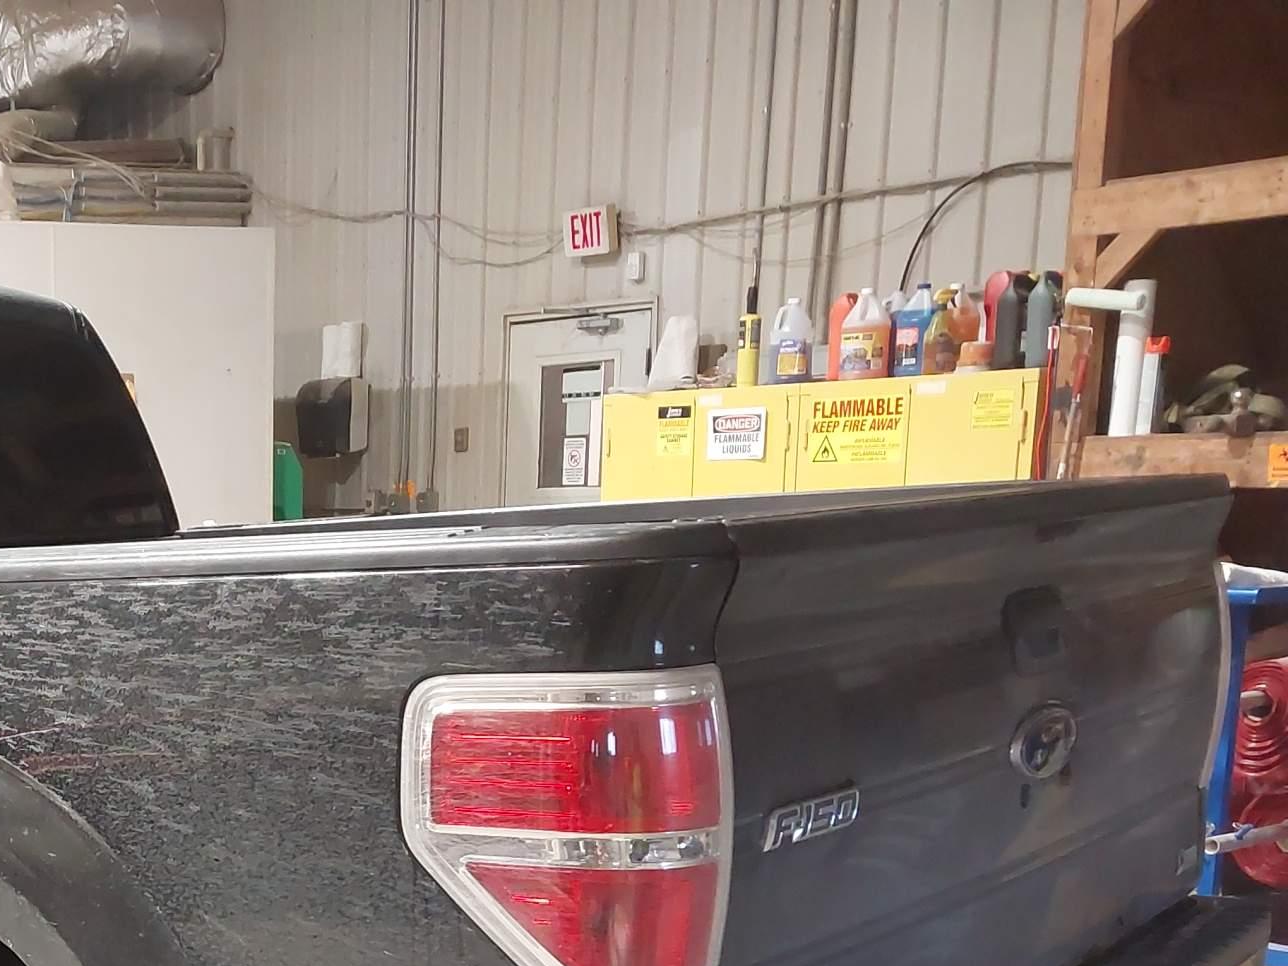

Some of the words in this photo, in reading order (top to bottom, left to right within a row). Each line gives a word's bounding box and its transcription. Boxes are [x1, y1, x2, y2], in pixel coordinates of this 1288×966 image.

[570, 211, 602, 250] EXIT
[813, 397, 903, 418] FLAMMABLE
[718, 417, 759, 430] DANGER
[811, 420, 840, 433] KEEP
[842, 418, 868, 433] FIRE
[869, 417, 901, 431] AWAY
[714, 432, 760, 443] FLAMMABLE
[722, 444, 752, 454] LIQUIDS
